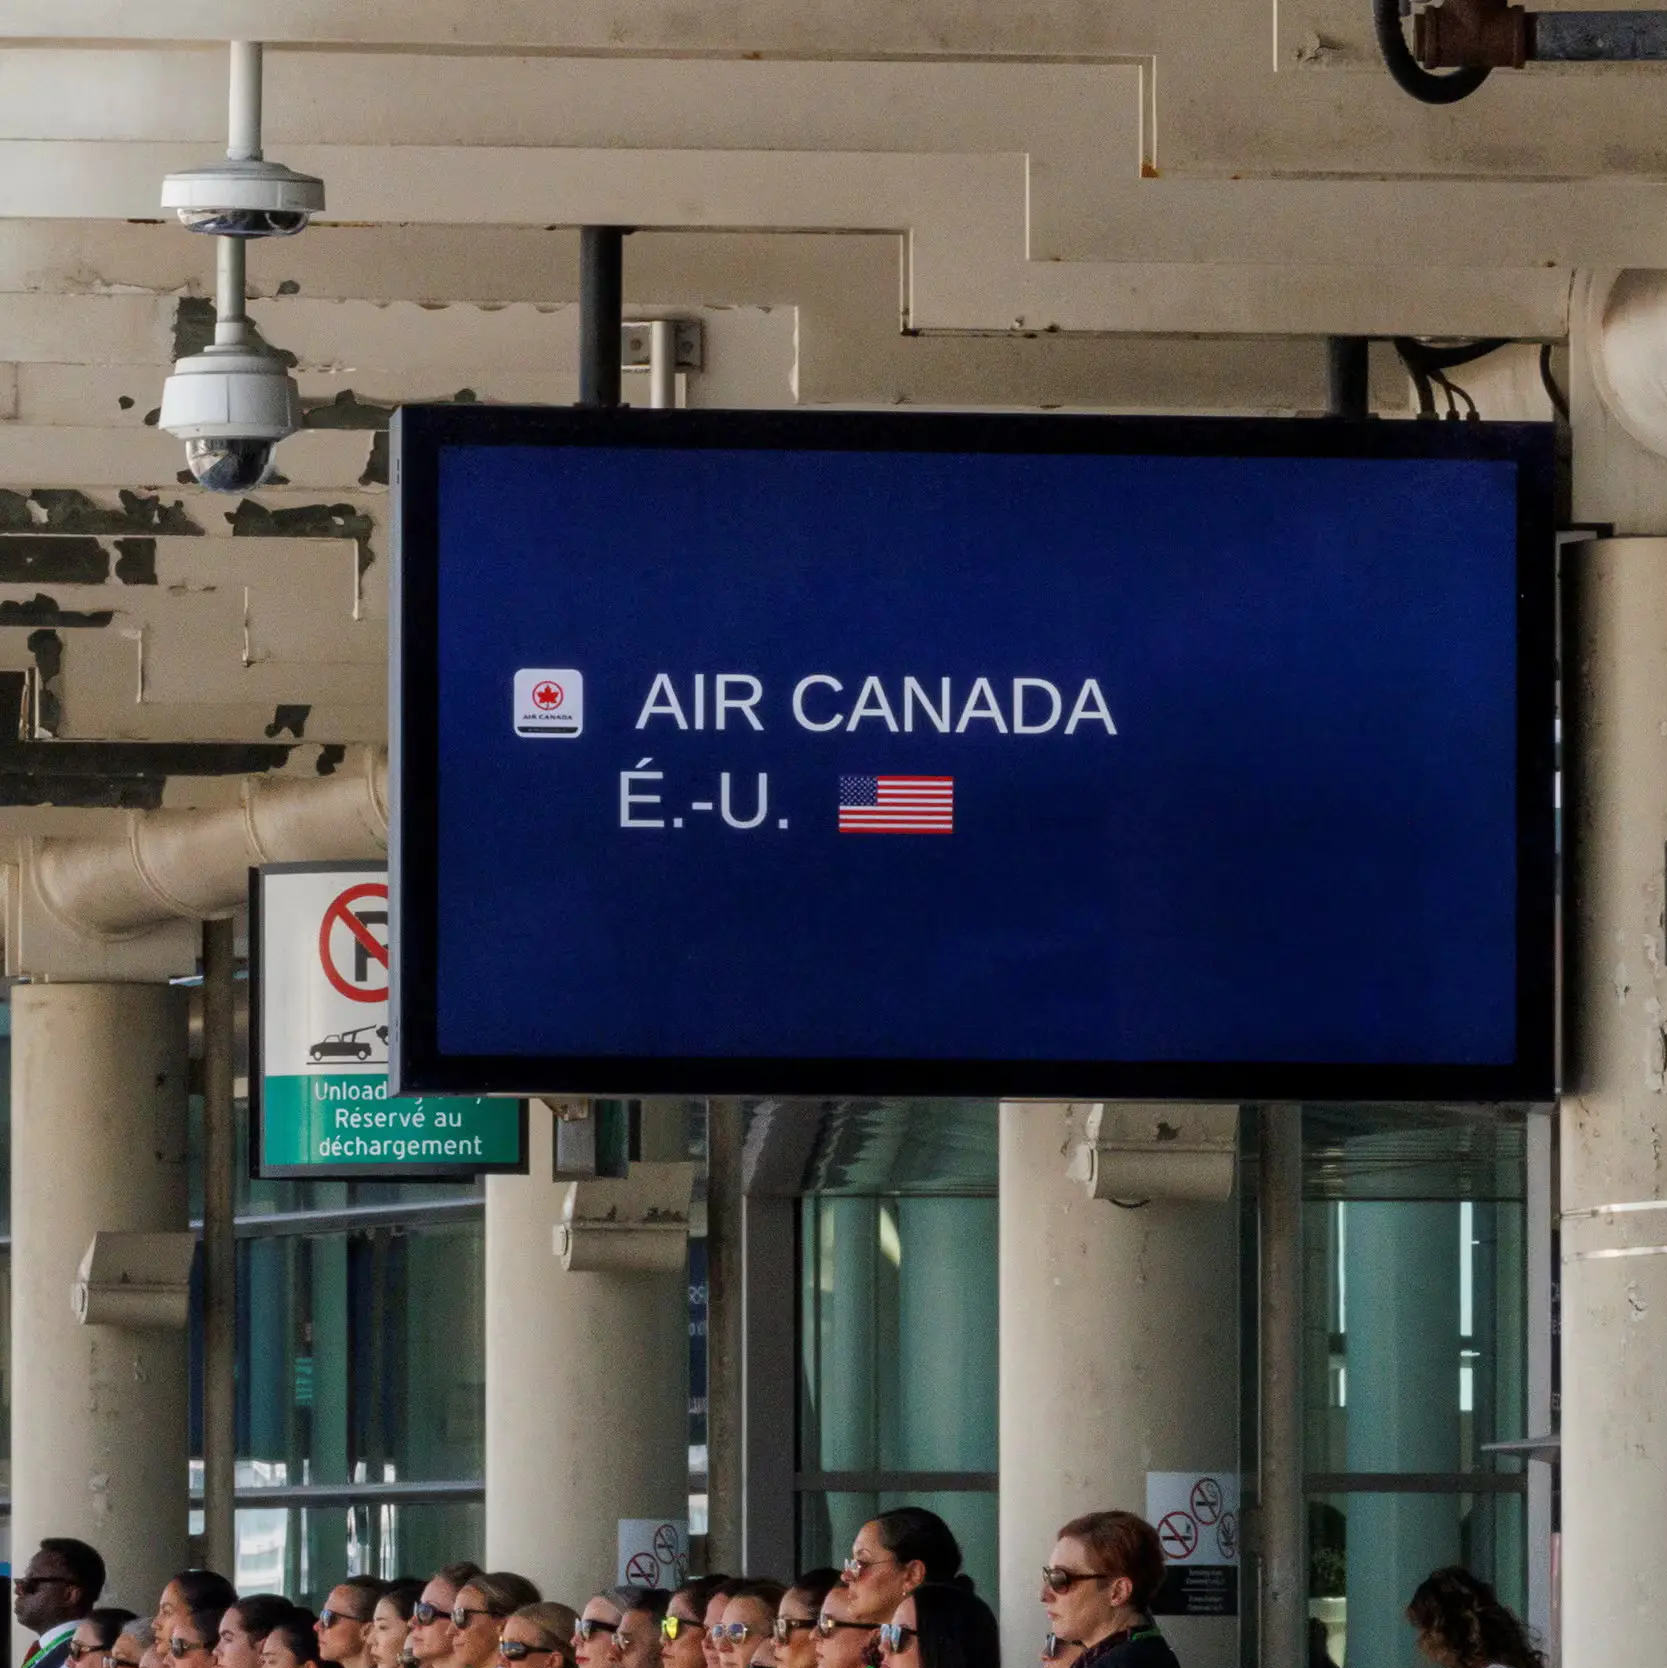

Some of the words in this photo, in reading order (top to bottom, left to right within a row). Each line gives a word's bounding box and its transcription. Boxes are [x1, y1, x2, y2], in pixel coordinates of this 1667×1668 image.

[636, 673, 764, 731] AIR
[792, 673, 1118, 736] CANADA
[620, 758, 788, 829] É.-U.
[335, 1107, 425, 1128] Réservé
[434, 1112, 462, 1127] au
[319, 1136, 482, 1160] déchargement
